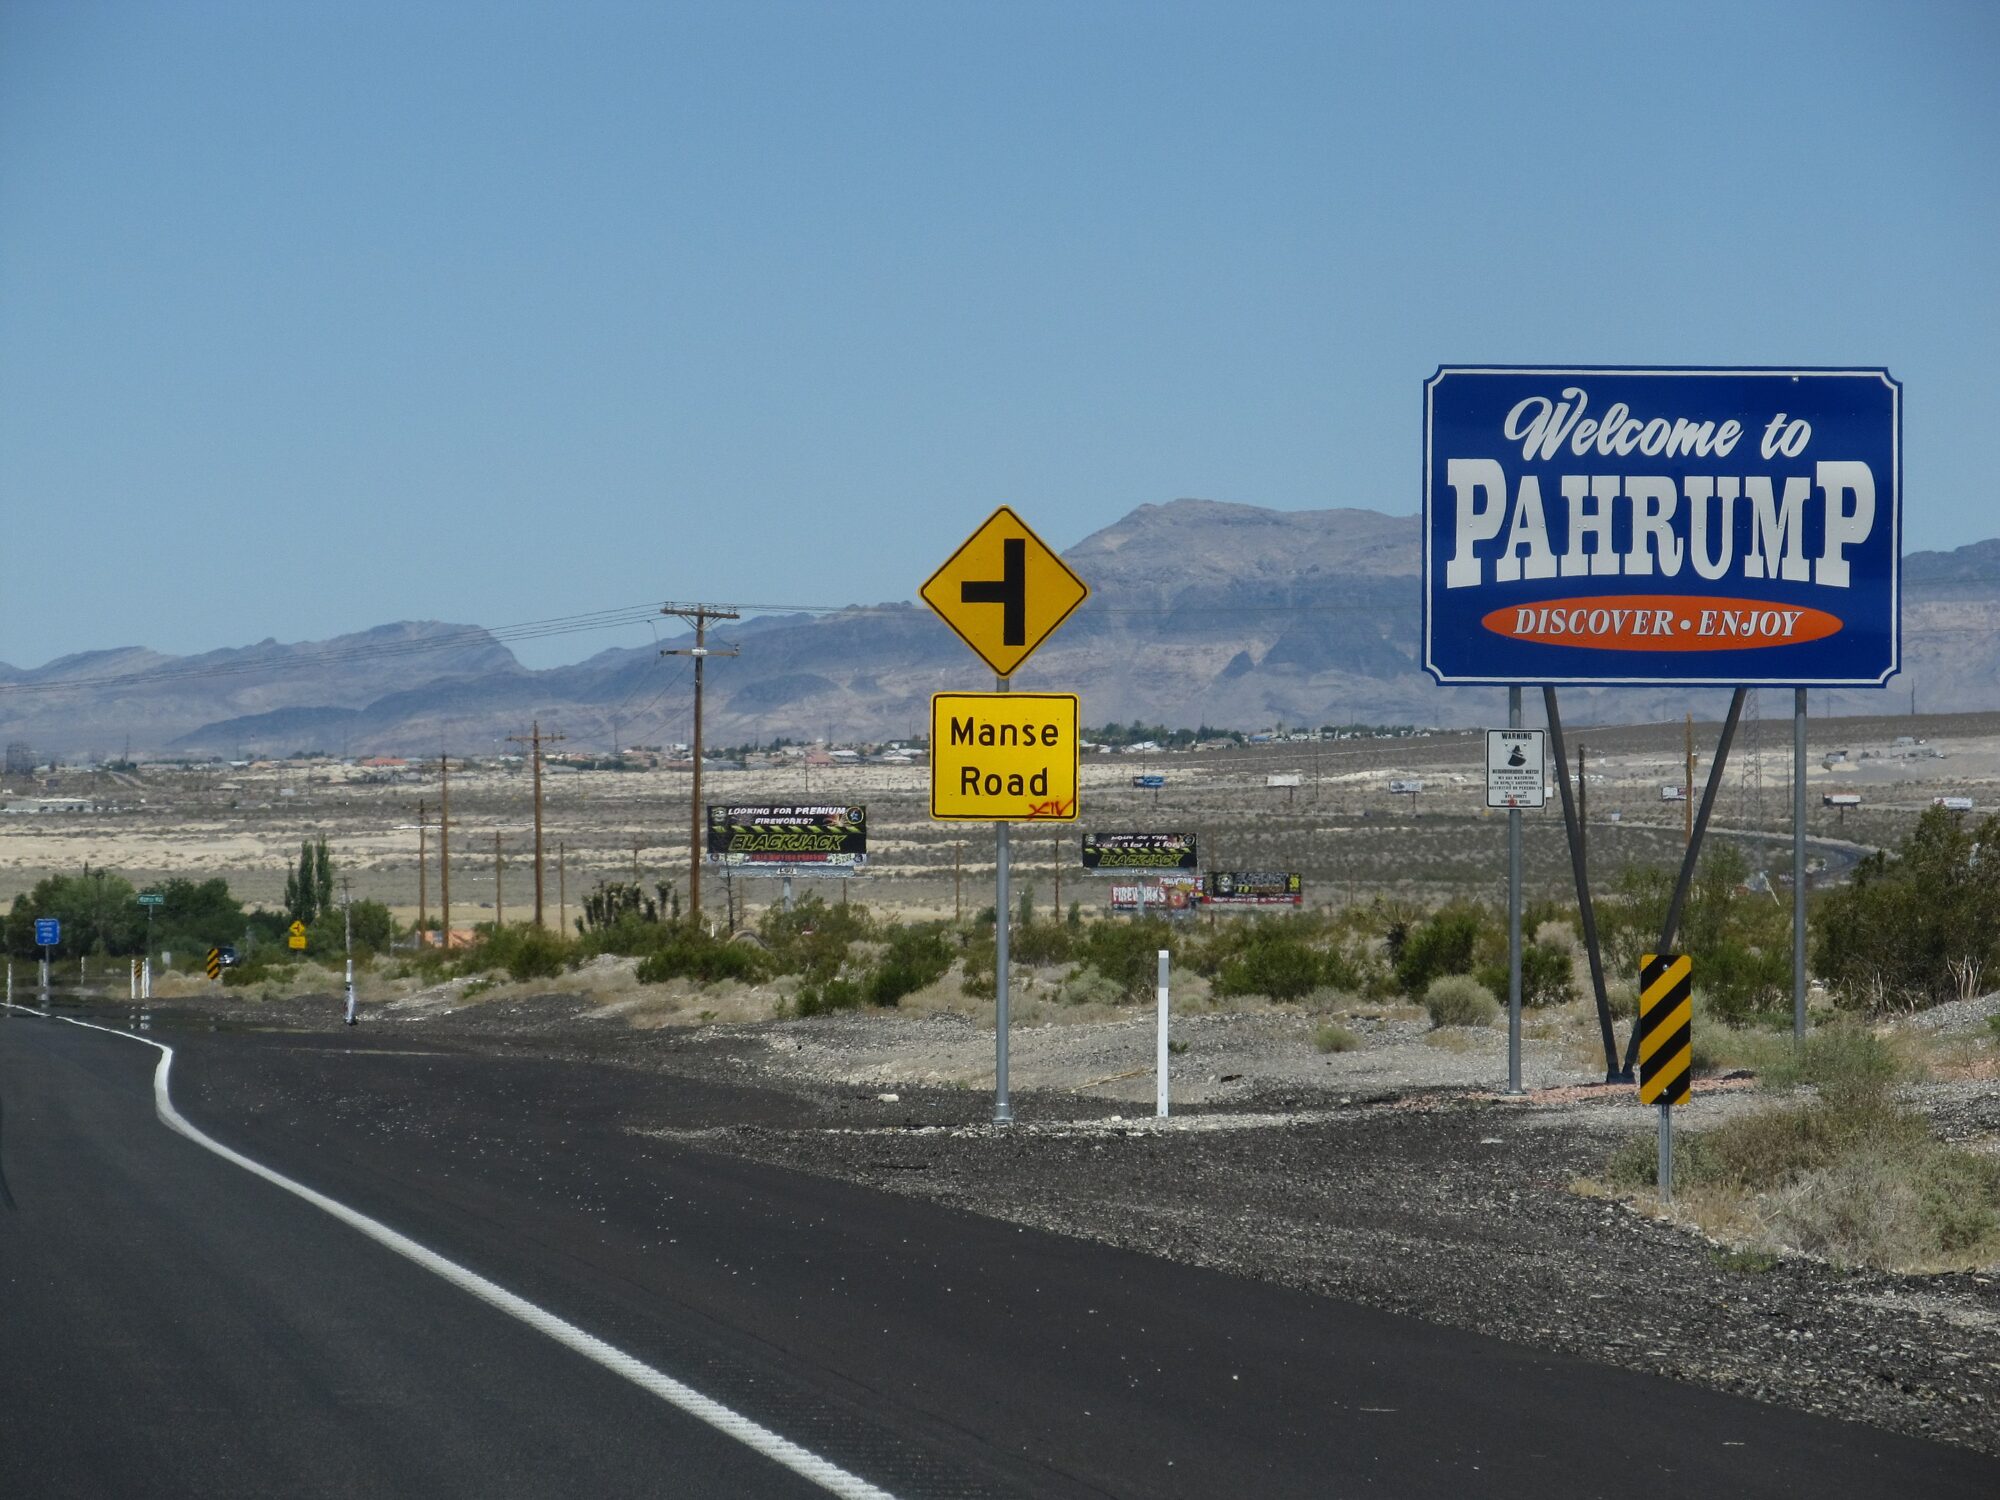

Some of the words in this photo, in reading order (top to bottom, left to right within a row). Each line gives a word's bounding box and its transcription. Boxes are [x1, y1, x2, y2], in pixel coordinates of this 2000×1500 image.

[1503, 387, 1744, 461] Welcome
[1760, 413, 1812, 460] to
[1446, 458, 1876, 589] PAHRUMP
[1513, 608, 1675, 637] DISCOVER
[1697, 611, 1803, 638] ENJOY
[951, 716, 1059, 747] Manse
[1501, 732, 1532, 740] WARNING
[961, 766, 1048, 797] Road
[728, 807, 770, 815] LOOKING
[773, 807, 792, 815] FOR
[795, 807, 846, 815] PREMIUM
[729, 834, 847, 850] BLACKJACK
[1112, 886, 1166, 902] FIREWRKS
